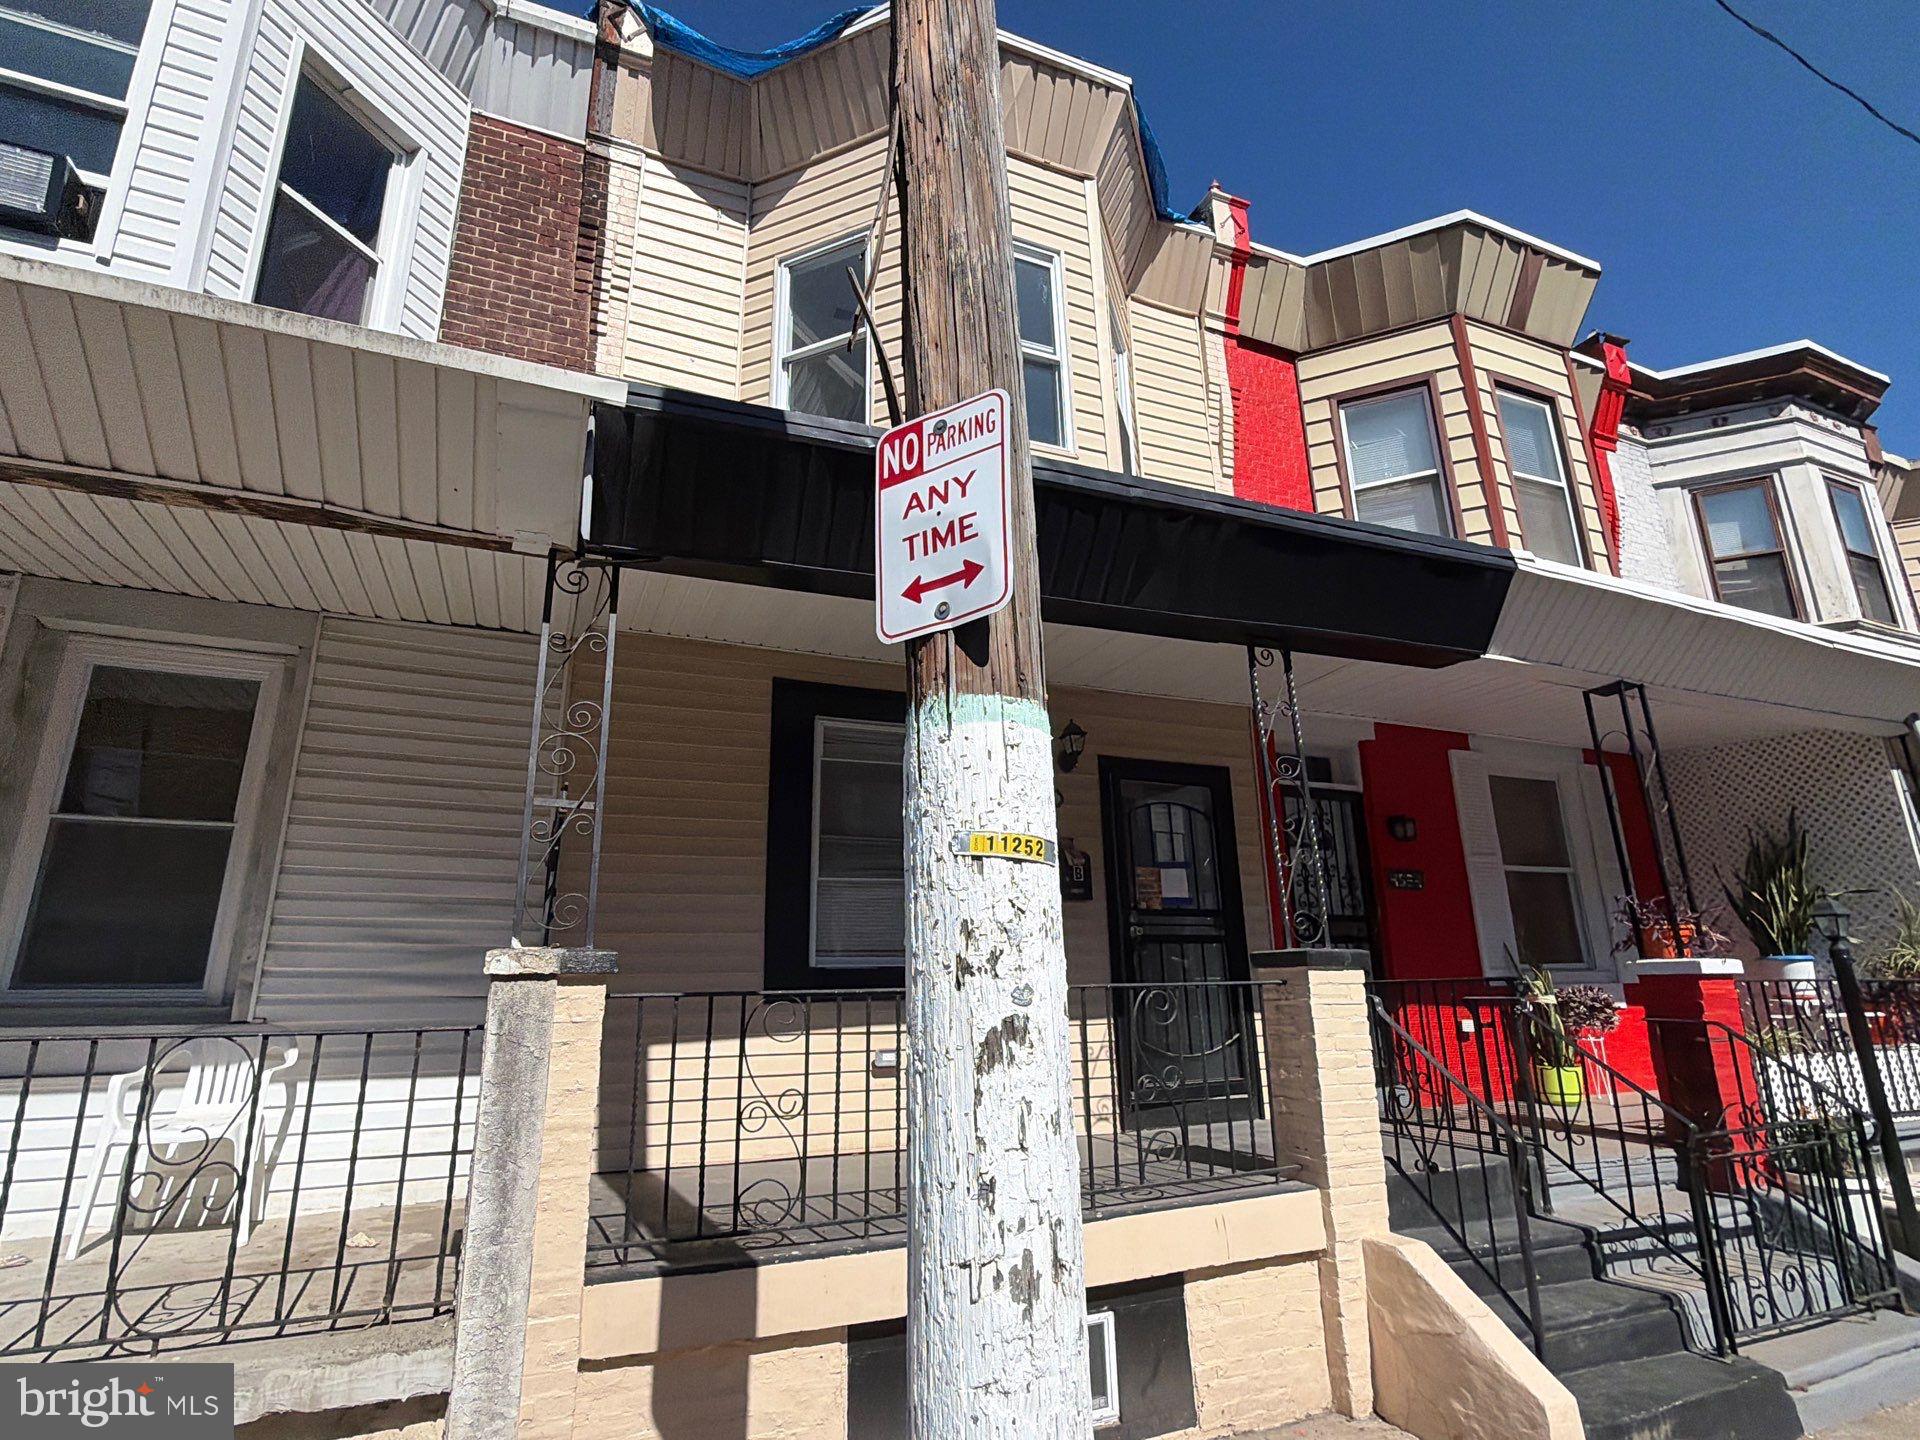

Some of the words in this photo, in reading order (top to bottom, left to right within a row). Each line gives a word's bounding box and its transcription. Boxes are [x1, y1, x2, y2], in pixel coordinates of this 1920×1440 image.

[883, 432, 919, 479] NO
[927, 408, 996, 457] PARKING
[902, 469, 977, 520] ANY
[902, 512, 979, 561] TIME
[987, 835, 1044, 857] 11252
